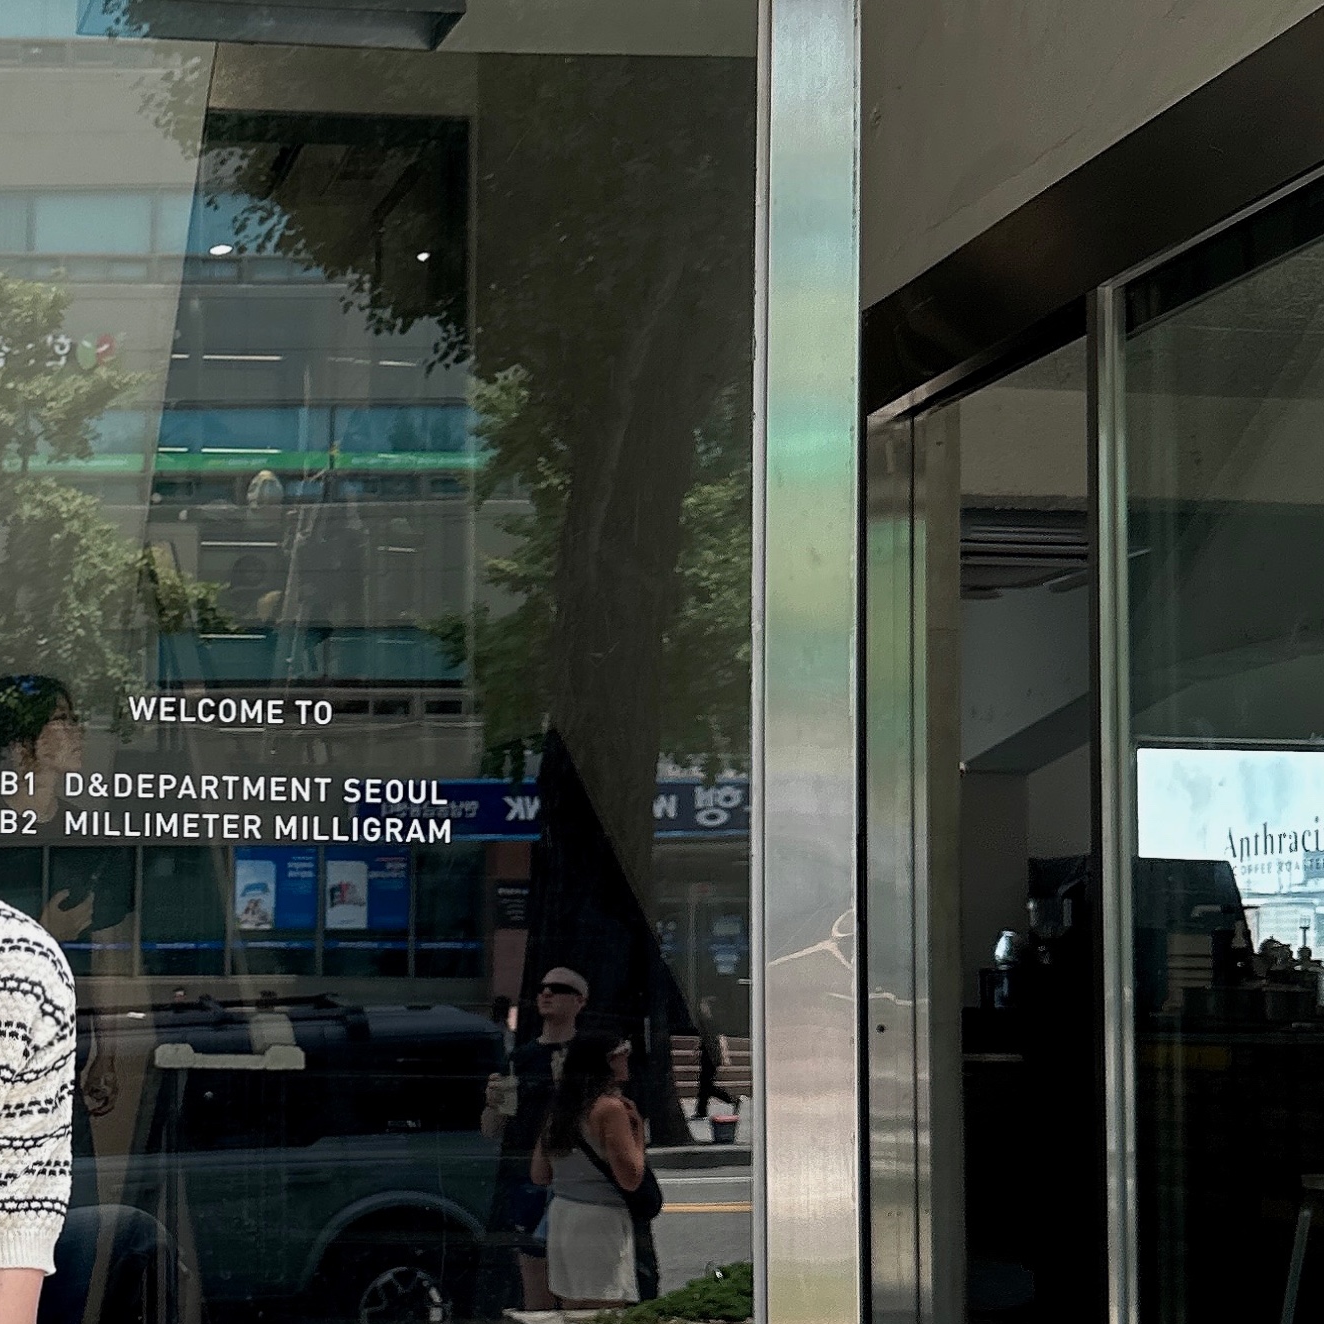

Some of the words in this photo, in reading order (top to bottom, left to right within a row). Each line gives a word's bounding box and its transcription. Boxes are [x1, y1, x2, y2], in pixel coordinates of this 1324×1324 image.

[128, 696, 284, 724] WELCOME
[295, 700, 332, 725] TO
[0, 770, 35, 796] B1
[65, 772, 332, 802] D&DEPARTMENT
[343, 778, 448, 805] SEOUL
[0, 809, 38, 835] B2
[65, 810, 261, 840] MILLIMETER
[275, 815, 452, 844] MILLIGRAM
[1224, 815, 1324, 862] Anthraci
[1277, 857, 1324, 873] ROASTE
